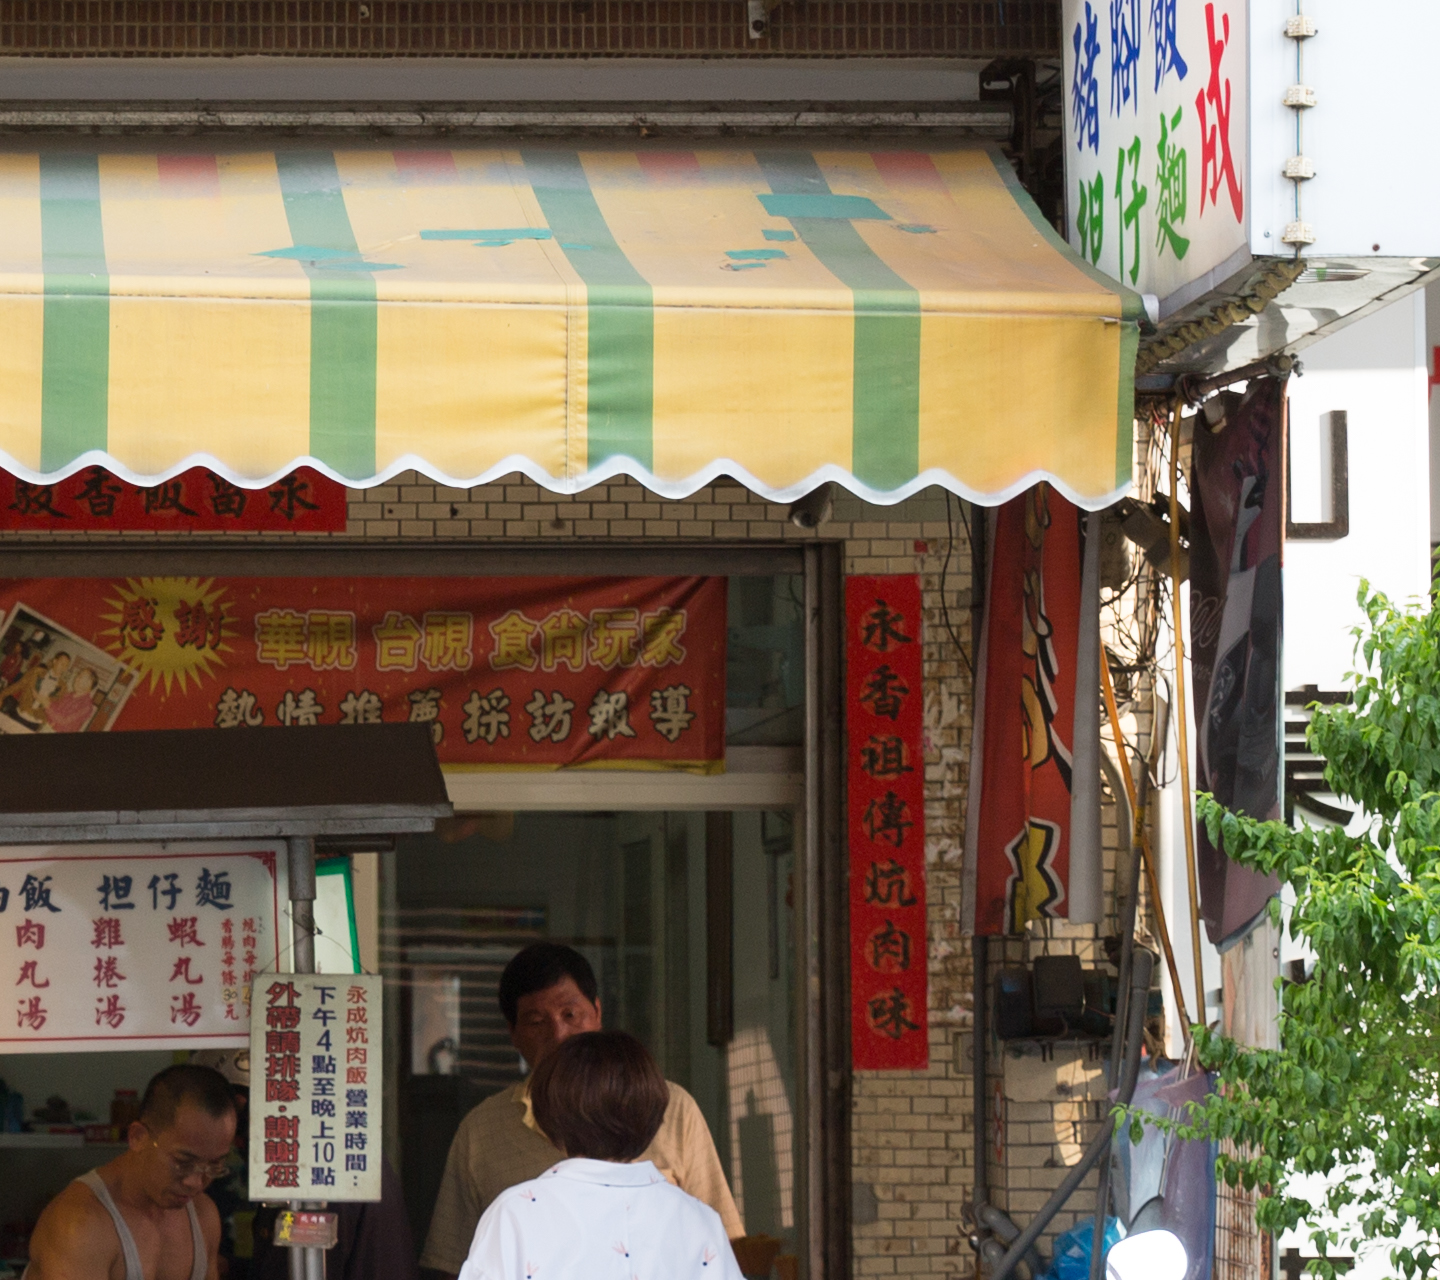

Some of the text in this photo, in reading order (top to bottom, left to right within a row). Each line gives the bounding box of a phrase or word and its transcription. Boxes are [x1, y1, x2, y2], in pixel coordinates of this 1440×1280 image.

[120, 596, 224, 651] 感謝
[255, 609, 689, 672] 華視 台視 食尚玩家
[96, 867, 234, 912] 担仔麵
[15, 917, 52, 1032] 肉丸湯
[90, 916, 127, 1030] 雞捲湯
[167, 915, 206, 1028] 蝦丸湯
[311, 986, 337, 1186] 下午4點至晚上10點
